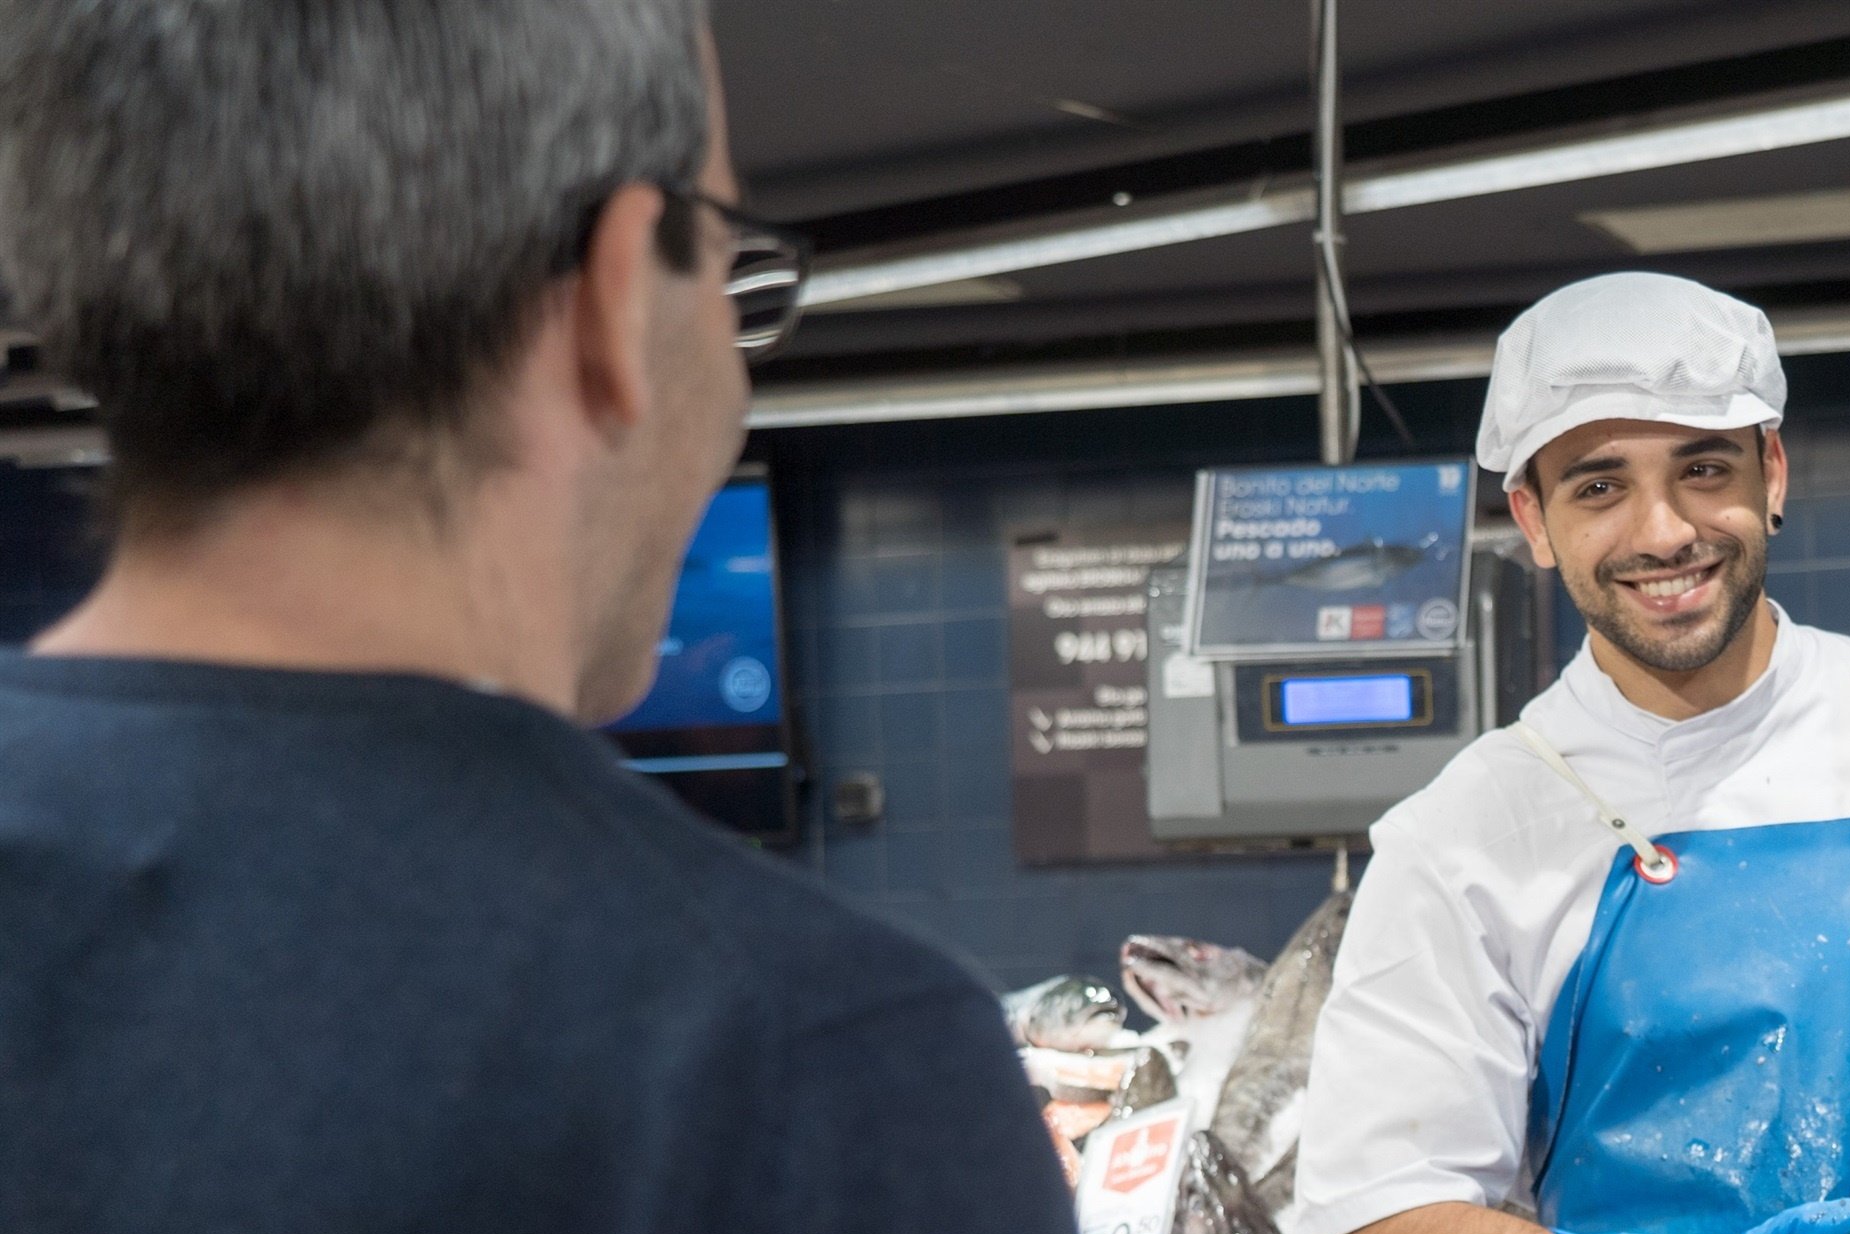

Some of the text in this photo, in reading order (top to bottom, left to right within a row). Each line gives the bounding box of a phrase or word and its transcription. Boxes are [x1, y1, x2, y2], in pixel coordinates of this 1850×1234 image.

[1216, 519, 1321, 539] Pescado
[1213, 541, 1261, 561] uno
[1265, 541, 1284, 560] a
